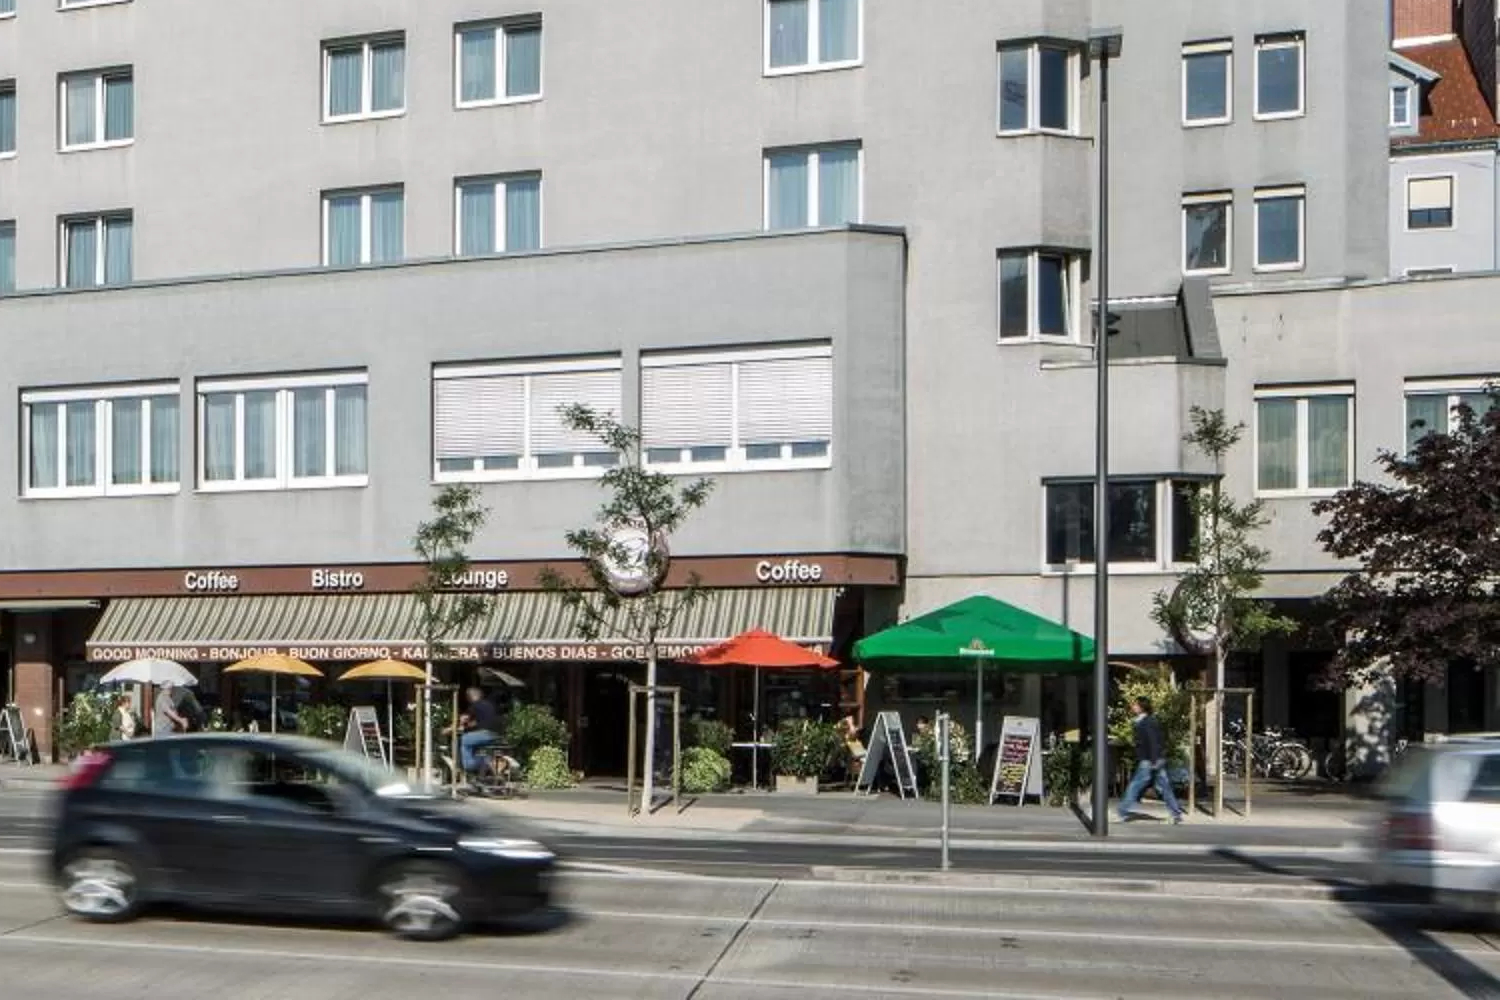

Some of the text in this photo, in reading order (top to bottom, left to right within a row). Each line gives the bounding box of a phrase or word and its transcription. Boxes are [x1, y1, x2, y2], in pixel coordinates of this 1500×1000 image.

[184, 571, 239, 590] Coffee
[311, 569, 364, 588] Bistro
[755, 561, 822, 581] Coffee
[92, 647, 133, 660] GOOD
[134, 647, 199, 660] MORNING
[289, 647, 330, 659] BUON
[493, 647, 556, 660] BUENOS
[561, 647, 597, 660] DIAS
